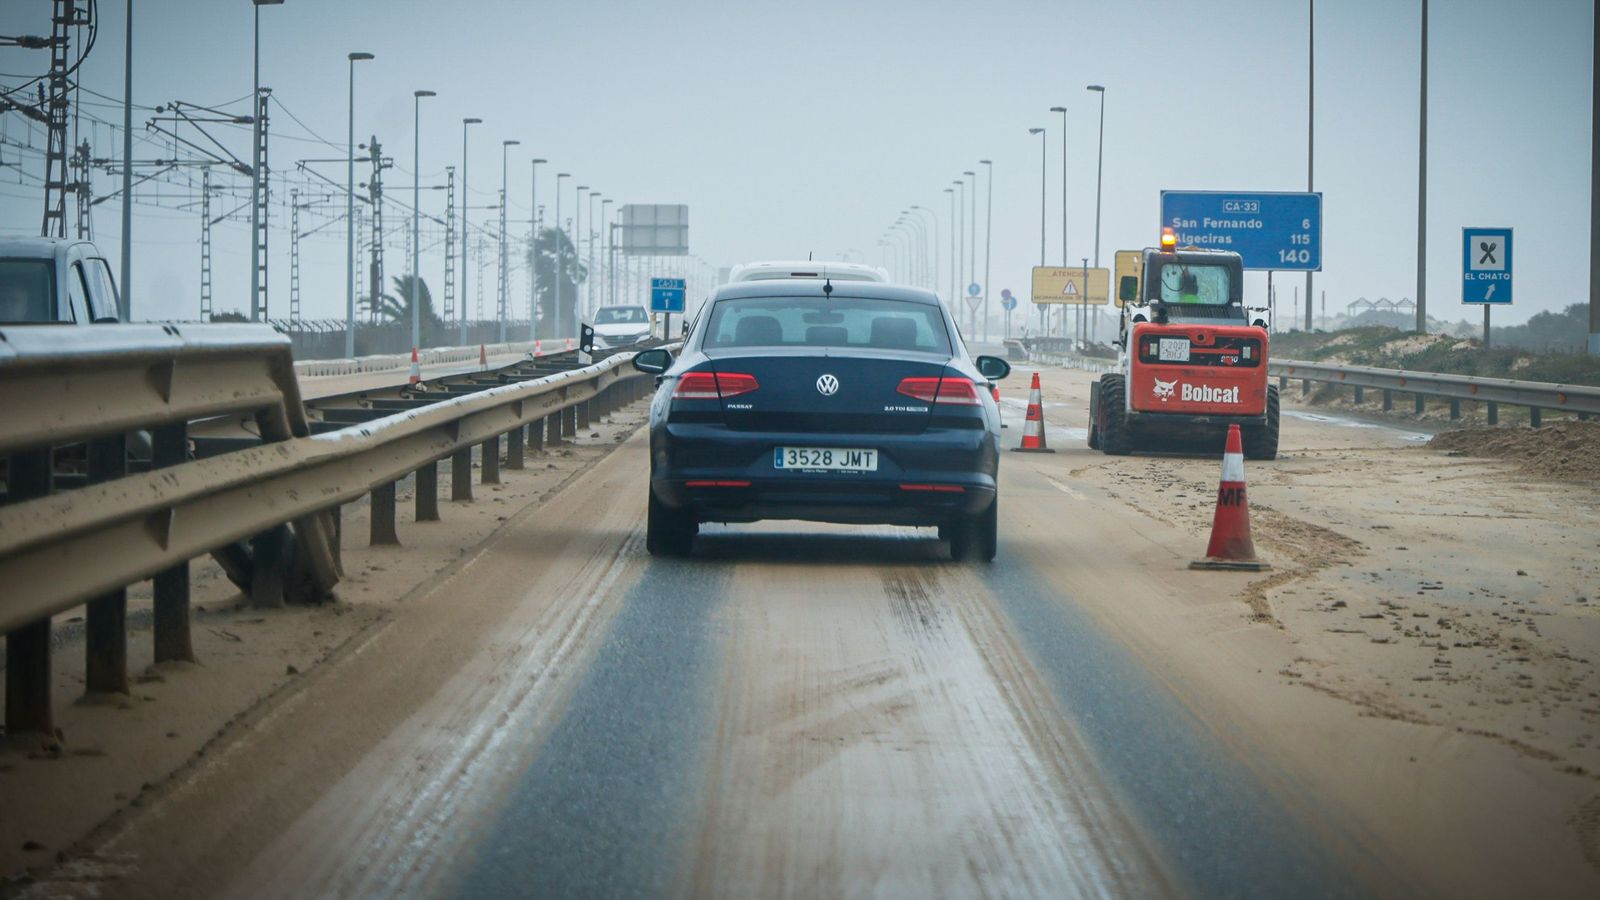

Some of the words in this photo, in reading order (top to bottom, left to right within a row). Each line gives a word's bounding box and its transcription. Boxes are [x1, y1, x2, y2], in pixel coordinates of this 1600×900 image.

[1225, 202, 1258, 211] CA-33
[1172, 217, 1197, 228] San
[1203, 217, 1263, 229] Fernando
[1302, 219, 1311, 229] 6
[1174, 233, 1233, 245] Algeciras
[1290, 234, 1310, 245] 115
[1279, 250, 1310, 263] 140
[665, 298, 670, 309] 1
[1181, 383, 1239, 403] Bobcat
[787, 450, 833, 466] 3528
[840, 451, 873, 468] JMT
[1220, 487, 1245, 507] MF
